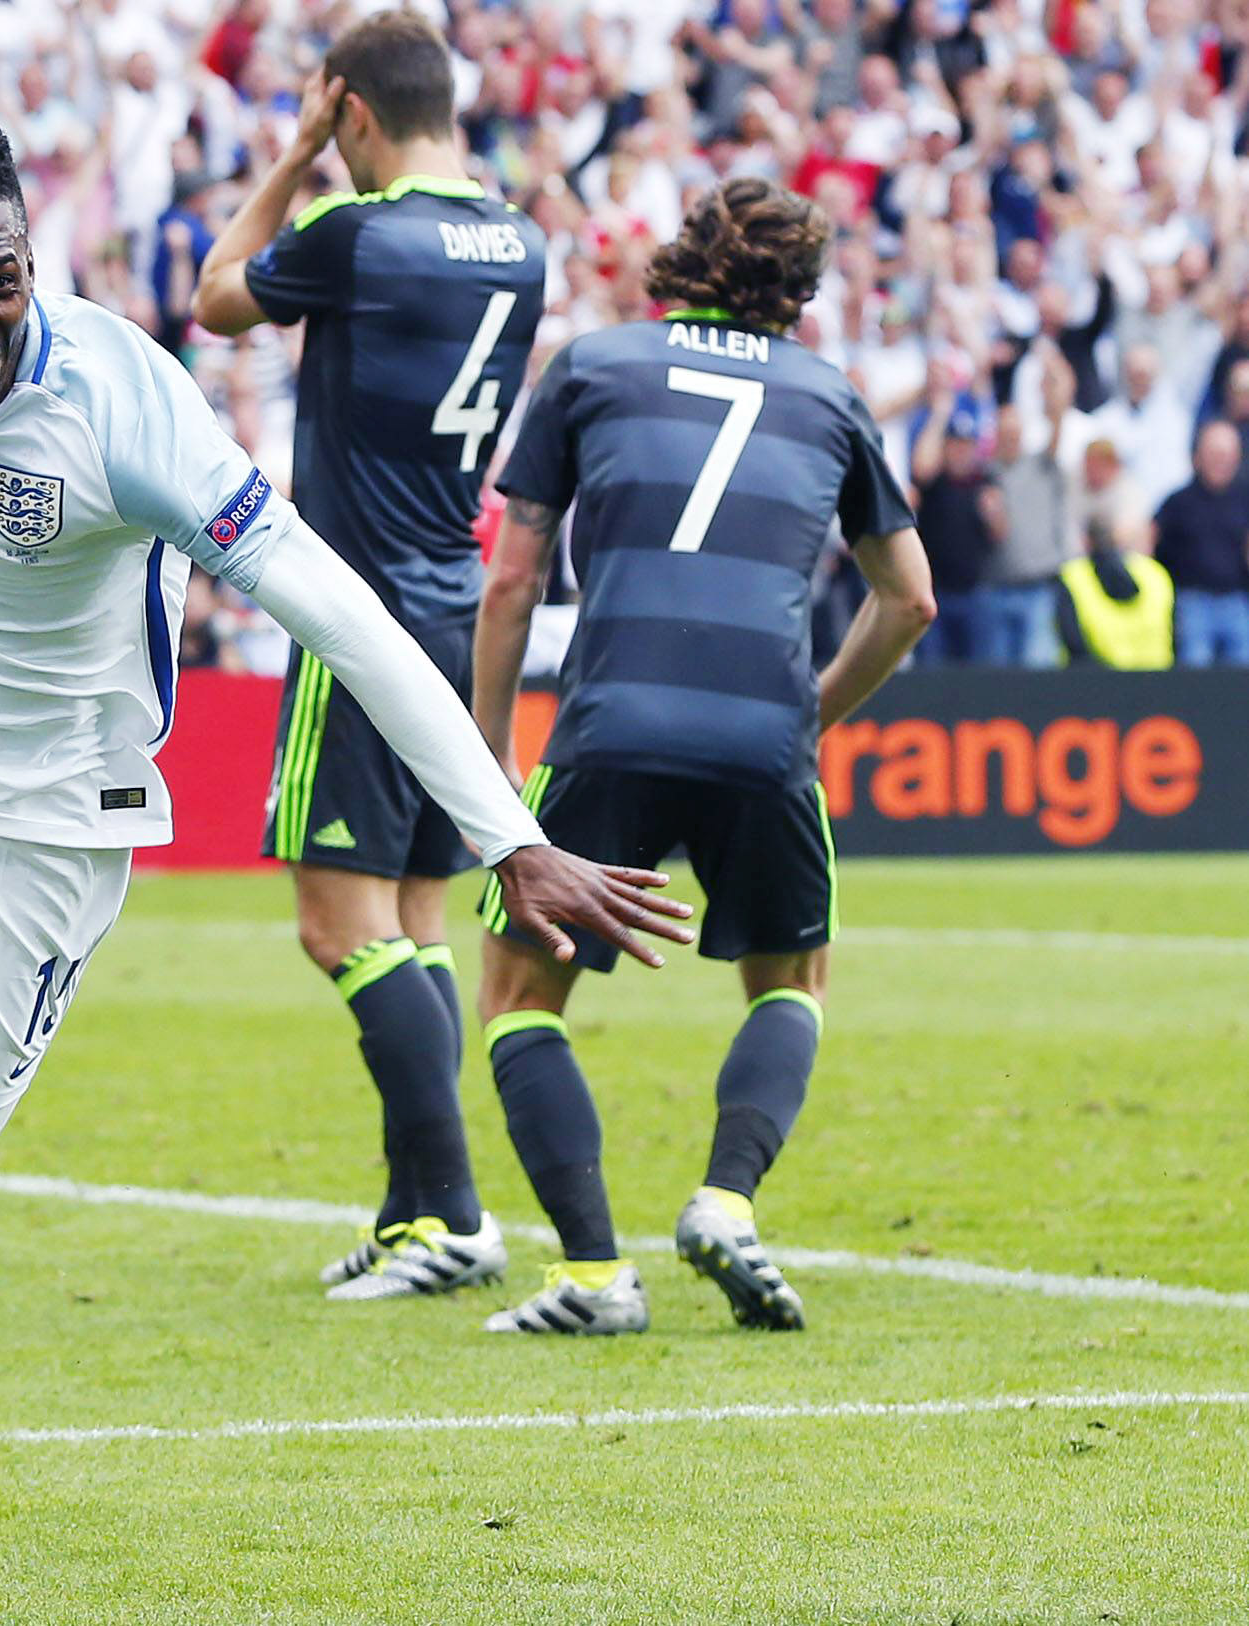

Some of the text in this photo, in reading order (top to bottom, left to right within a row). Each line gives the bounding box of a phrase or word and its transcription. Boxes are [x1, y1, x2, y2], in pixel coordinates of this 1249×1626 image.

[438, 221, 527, 264] DAVIES
[431, 290, 518, 473] 4
[666, 322, 770, 364] ALLEN
[230, 472, 268, 525] RESPECT
[666, 365, 766, 554] 7
[817, 713, 1204, 849] range
